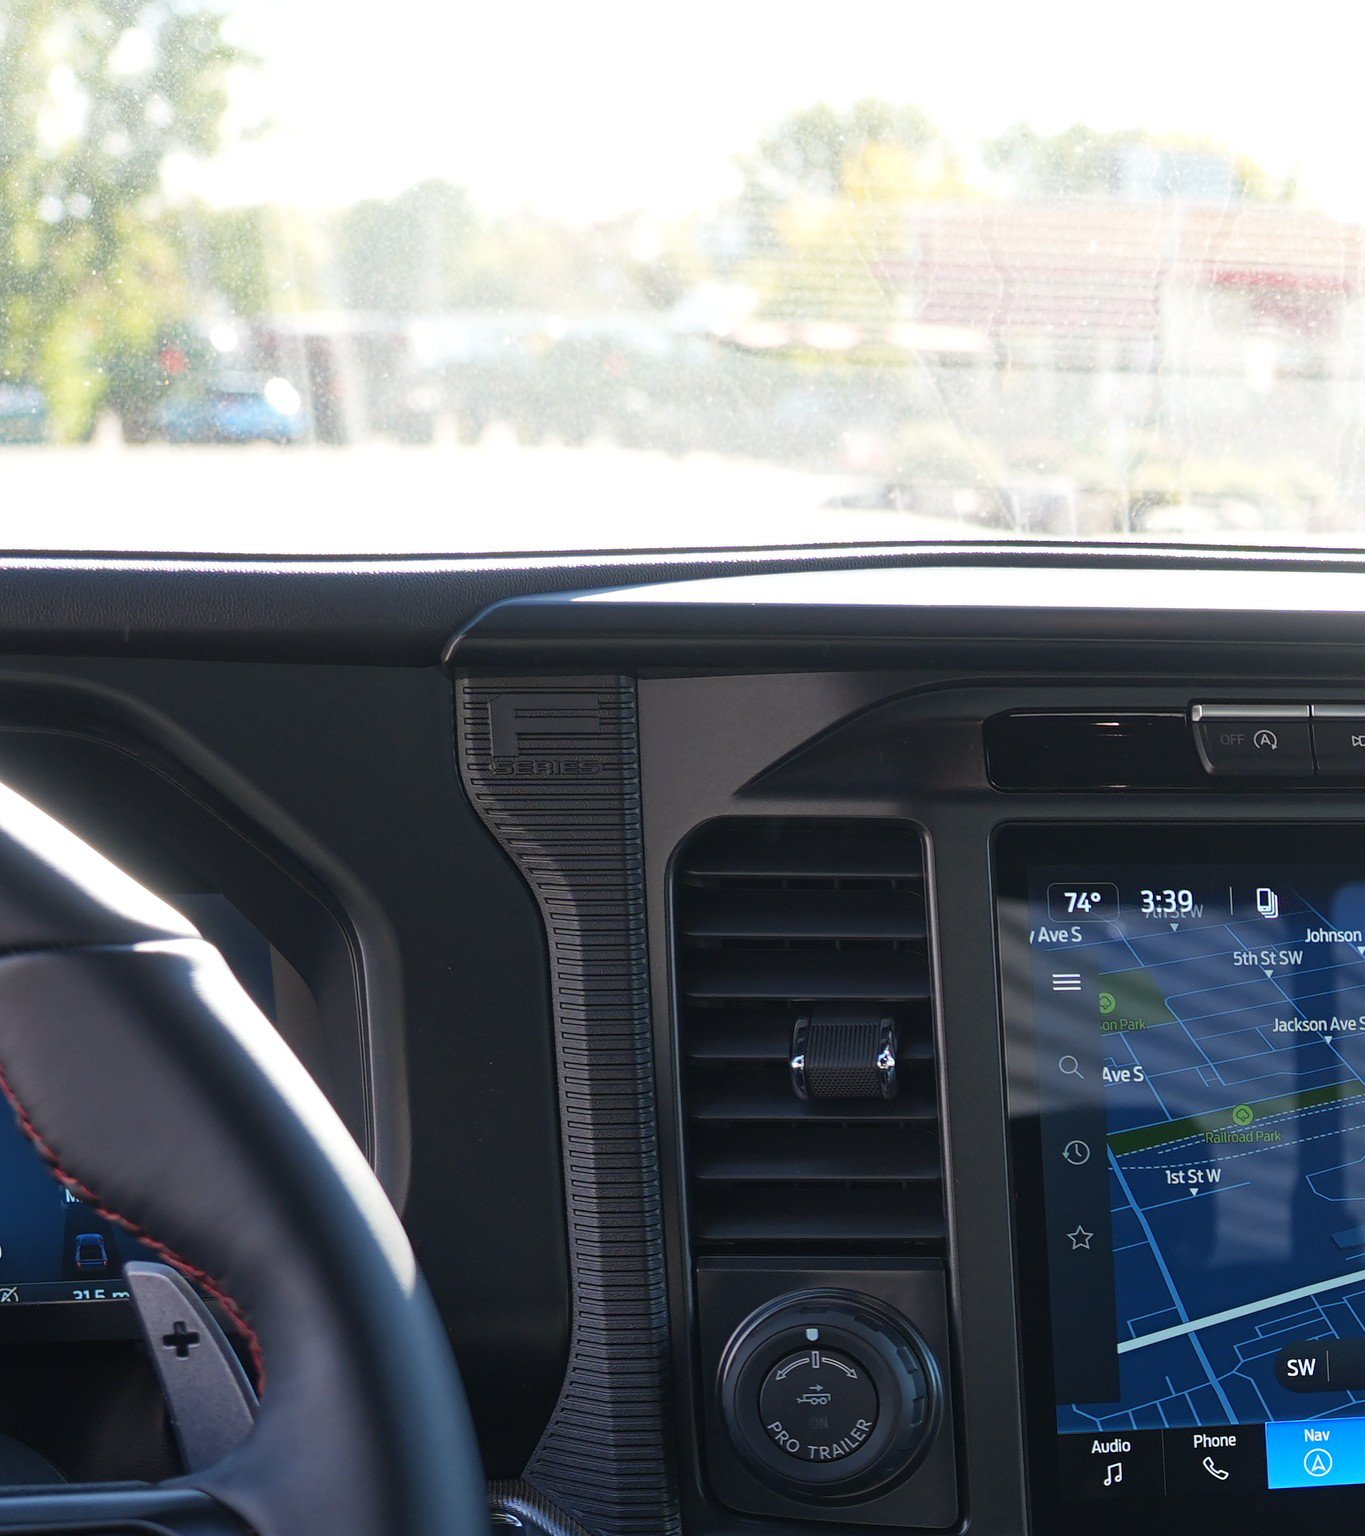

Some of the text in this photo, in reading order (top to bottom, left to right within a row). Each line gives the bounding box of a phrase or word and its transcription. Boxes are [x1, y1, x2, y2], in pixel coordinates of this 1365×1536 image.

[1221, 734, 1244, 745] OFF
[492, 759, 600, 776] SERIES
[1064, 892, 1101, 914] 74°
[1141, 890, 1193, 914] 3:39
[1038, 927, 1068, 942] Ave
[1071, 927, 1082, 942] S
[1305, 928, 1362, 943] Johnson
[1233, 950, 1303, 966] 5th St SW
[1120, 1019, 1146, 1030] Park
[1273, 1017, 1327, 1032] Jackson
[1329, 1017, 1356, 1031] Ave
[1102, 1066, 1144, 1082] Ave S
[1205, 1129, 1281, 1144] Railroad Park
[1166, 1168, 1221, 1184] 1st St W
[1287, 1359, 1315, 1377] SW
[767, 1419, 872, 1460] PRO TRAILER
[1193, 1433, 1236, 1448] Phone
[1304, 1429, 1330, 1442] Nav
[1092, 1438, 1131, 1454] Audio
